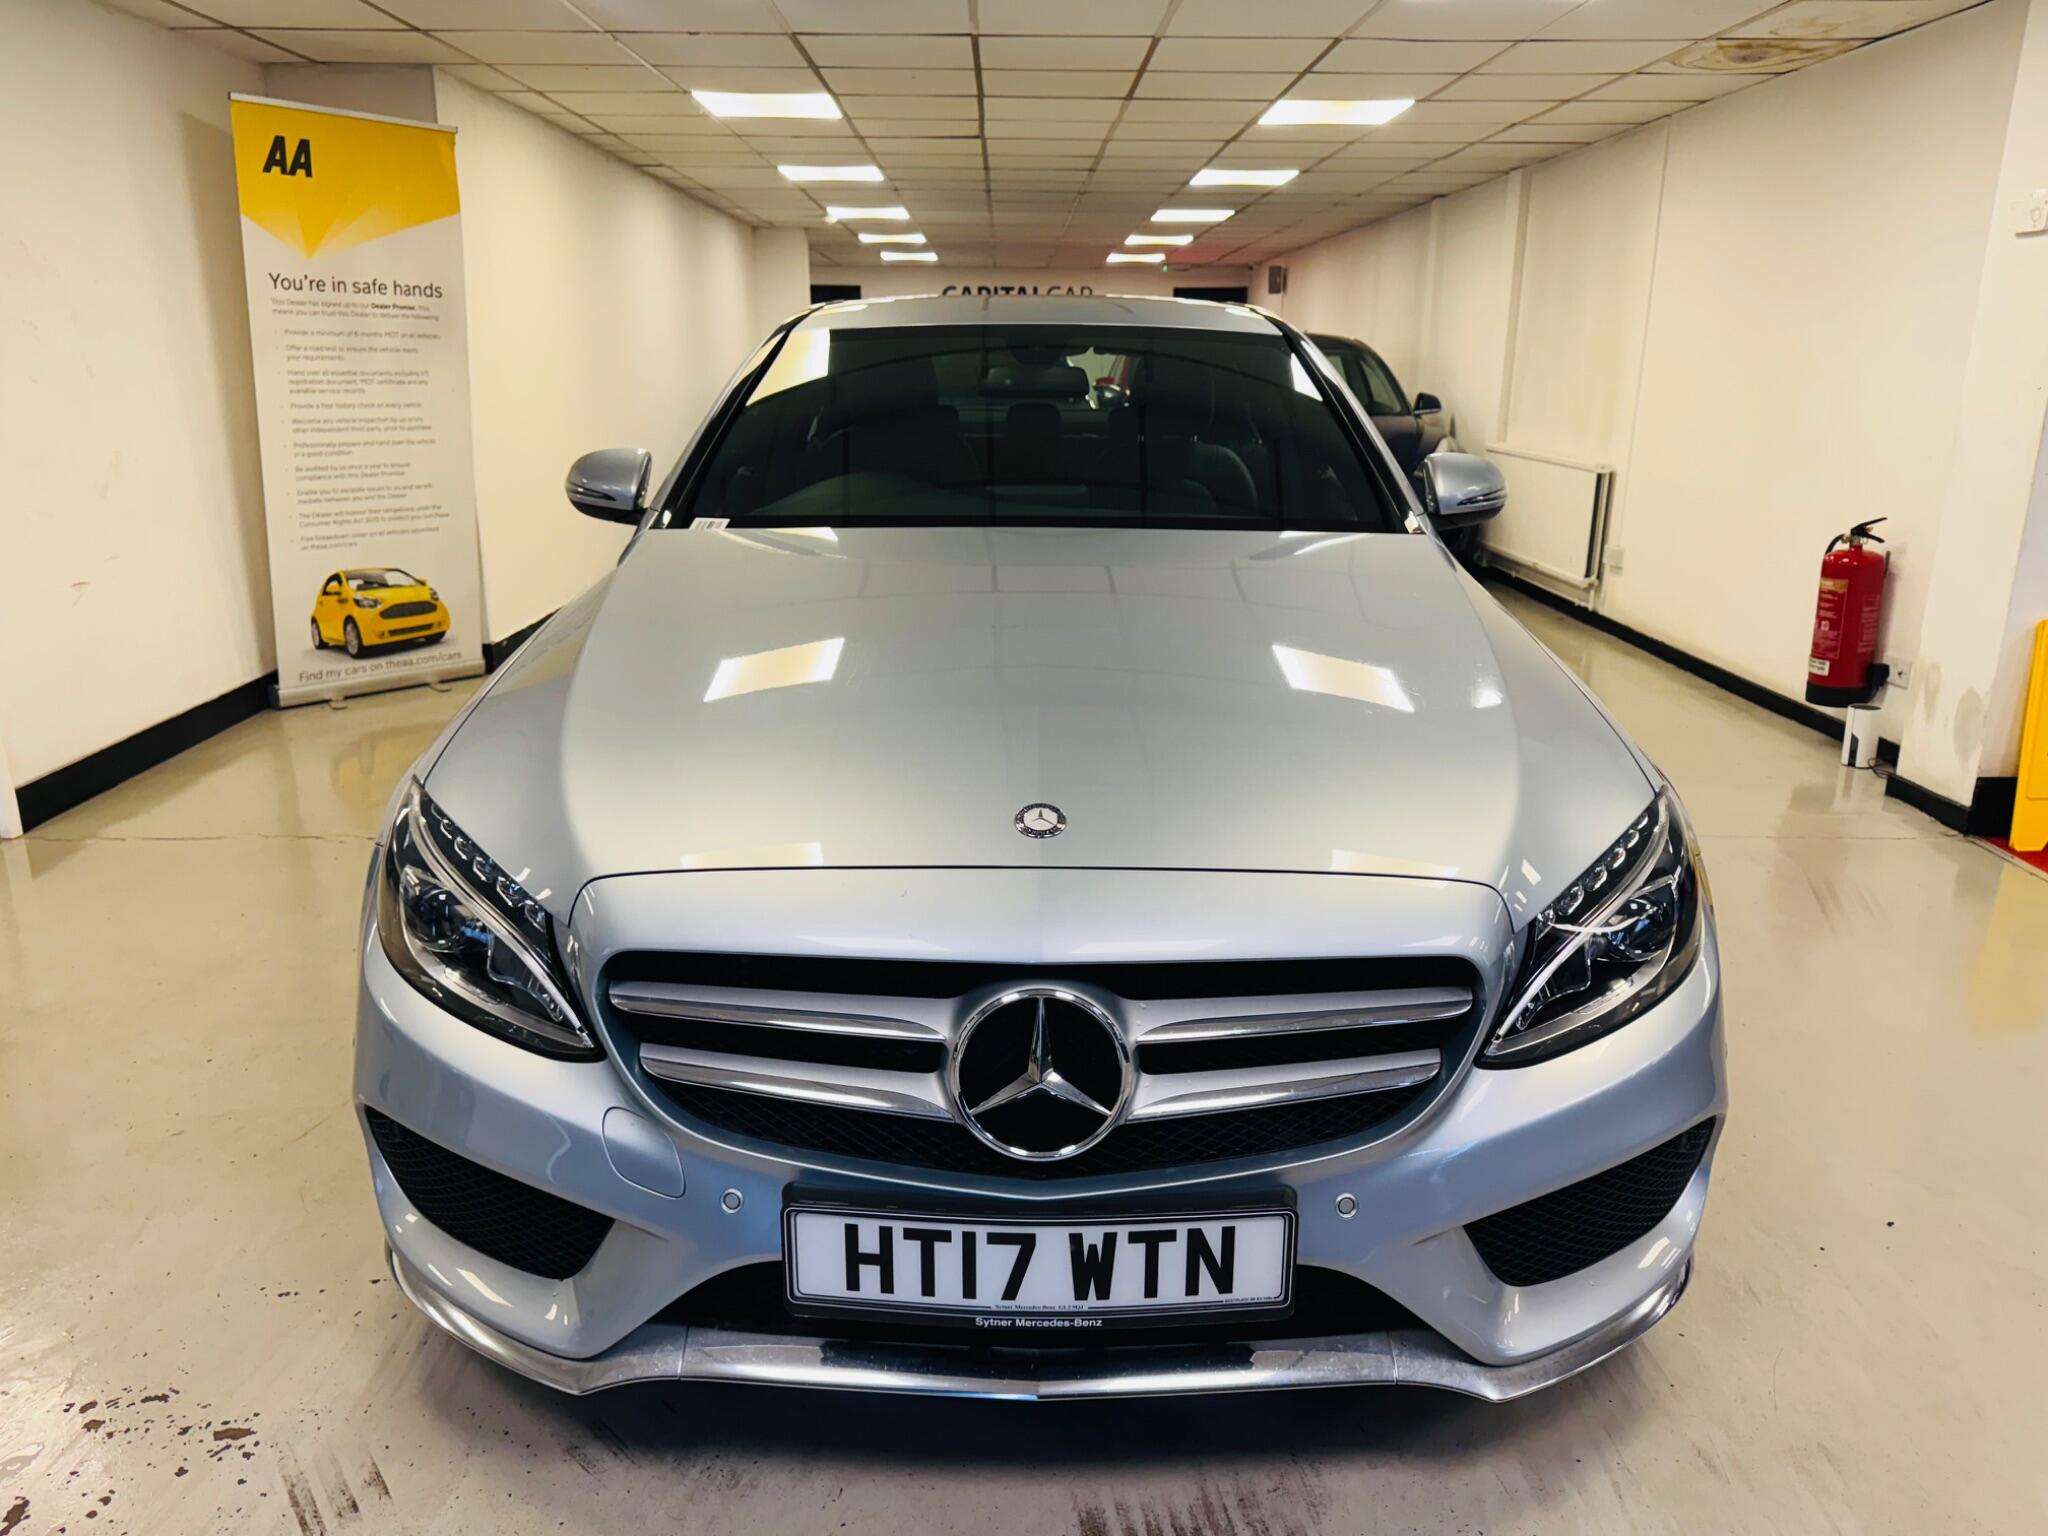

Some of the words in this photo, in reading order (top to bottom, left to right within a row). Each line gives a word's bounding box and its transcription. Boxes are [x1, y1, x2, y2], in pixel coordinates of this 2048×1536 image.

[262, 134, 313, 178] AA
[268, 272, 326, 292] You're
[331, 276, 347, 293] in
[352, 278, 388, 295] safe
[393, 280, 443, 299] hands
[299, 670, 323, 682] Find
[325, 669, 341, 679] my
[345, 664, 367, 676] cars
[370, 662, 384, 671] on
[844, 1222, 1037, 1301] HT17
[1069, 1225, 1236, 1301] WTN
[975, 1317, 1012, 1329] Sytner
[1015, 1318, 1102, 1328] Mercedes-Benz
